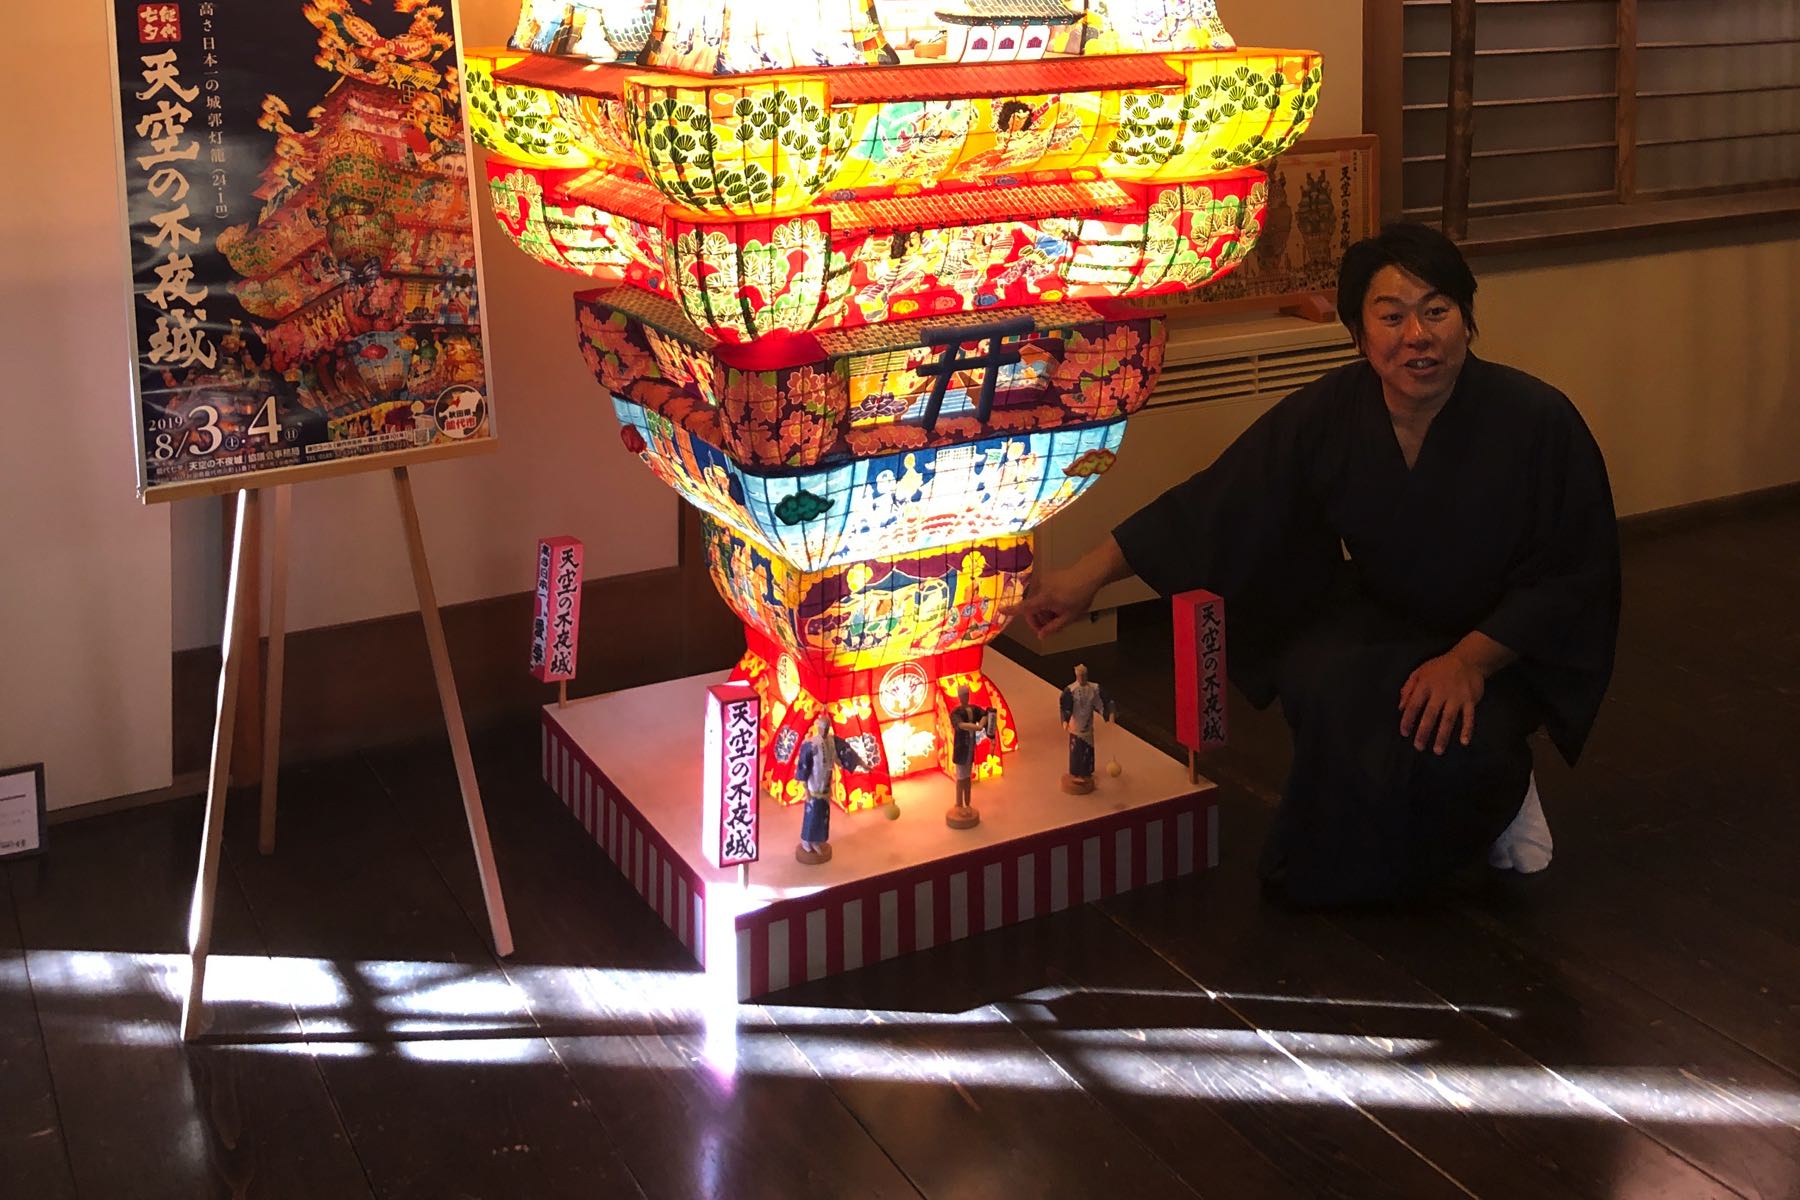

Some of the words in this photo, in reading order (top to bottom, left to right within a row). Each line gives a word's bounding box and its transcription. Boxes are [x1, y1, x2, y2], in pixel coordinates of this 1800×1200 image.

[135, 49, 217, 369] 天空の不夜城
[148, 415, 183, 431] 2019
[446, 417, 476, 431] 能代市
[550, 547, 579, 675] 天空の不夜城
[1202, 604, 1223, 740] 天空の不夜城
[725, 702, 757, 857] 天空の不夜城
